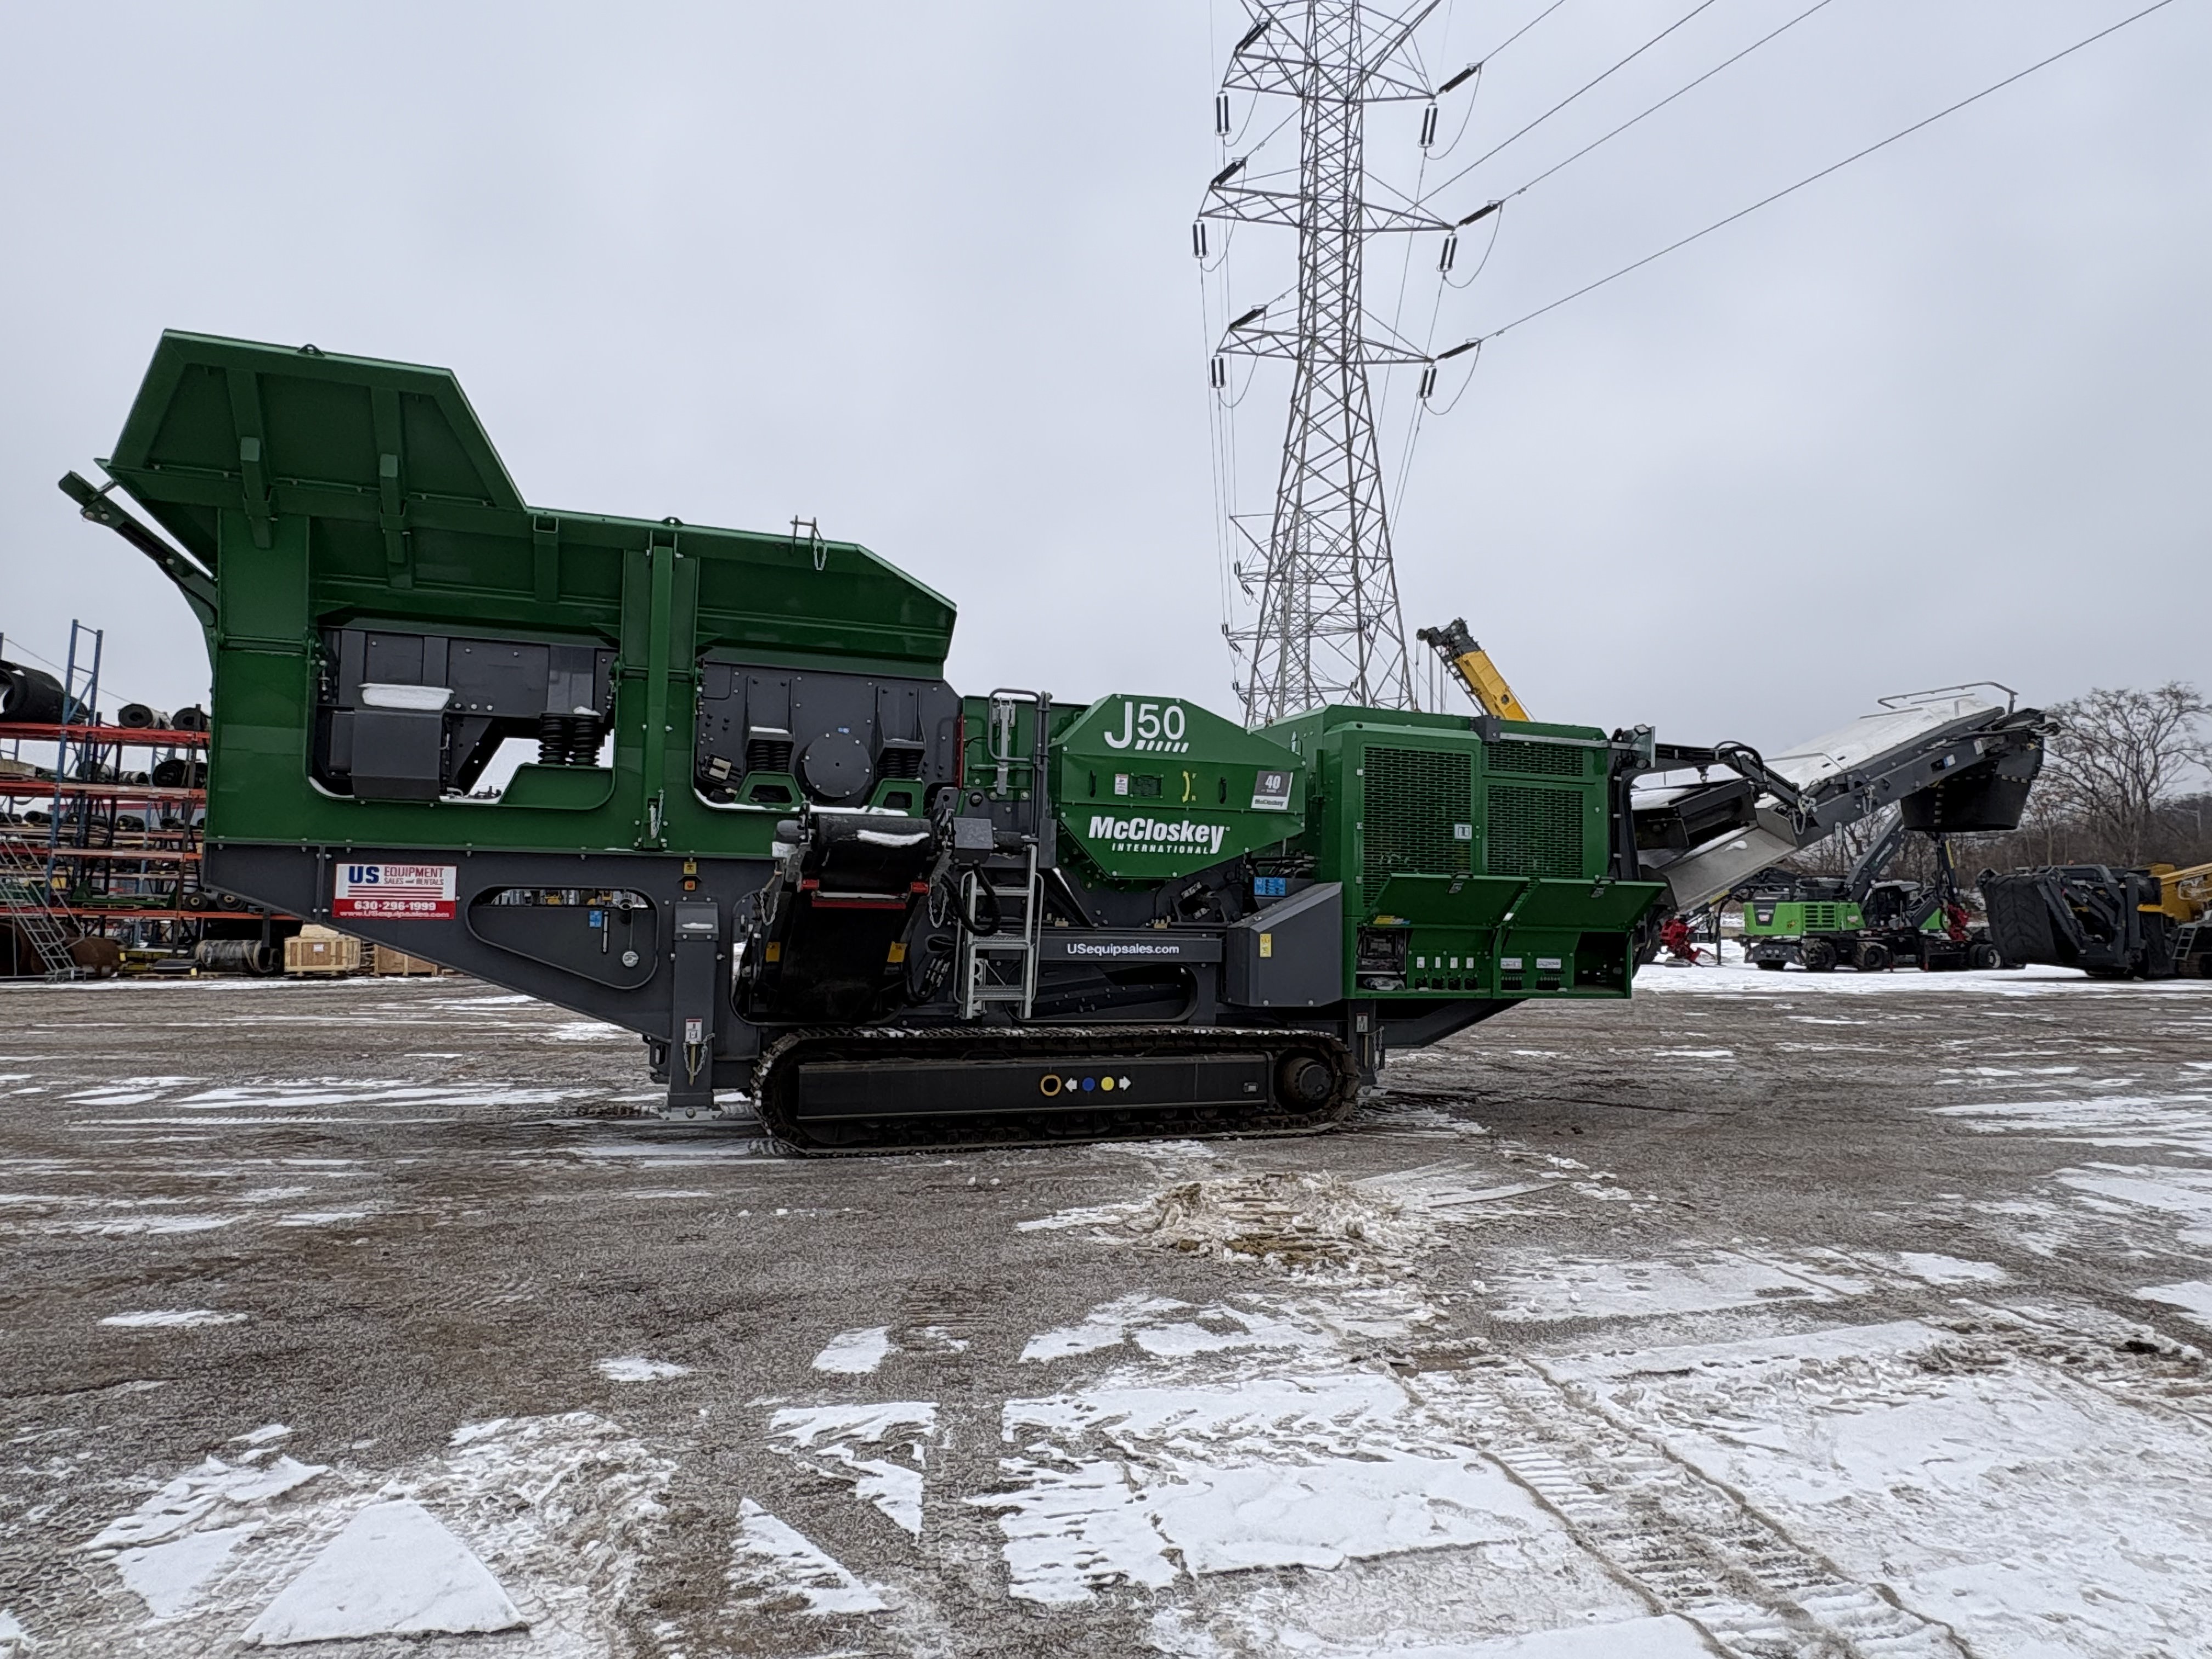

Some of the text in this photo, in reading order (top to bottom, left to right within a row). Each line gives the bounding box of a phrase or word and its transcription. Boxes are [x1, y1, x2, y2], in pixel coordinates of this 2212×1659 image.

[1104, 701, 1185, 748] J50
[1265, 775, 1281, 789] 40
[1088, 816, 1225, 854] McCloskey
[1111, 843, 1208, 854] INTERNATIONAL
[349, 866, 444, 884] US EQUIPMENT
[1066, 943, 1180, 957] USequipsales.com
